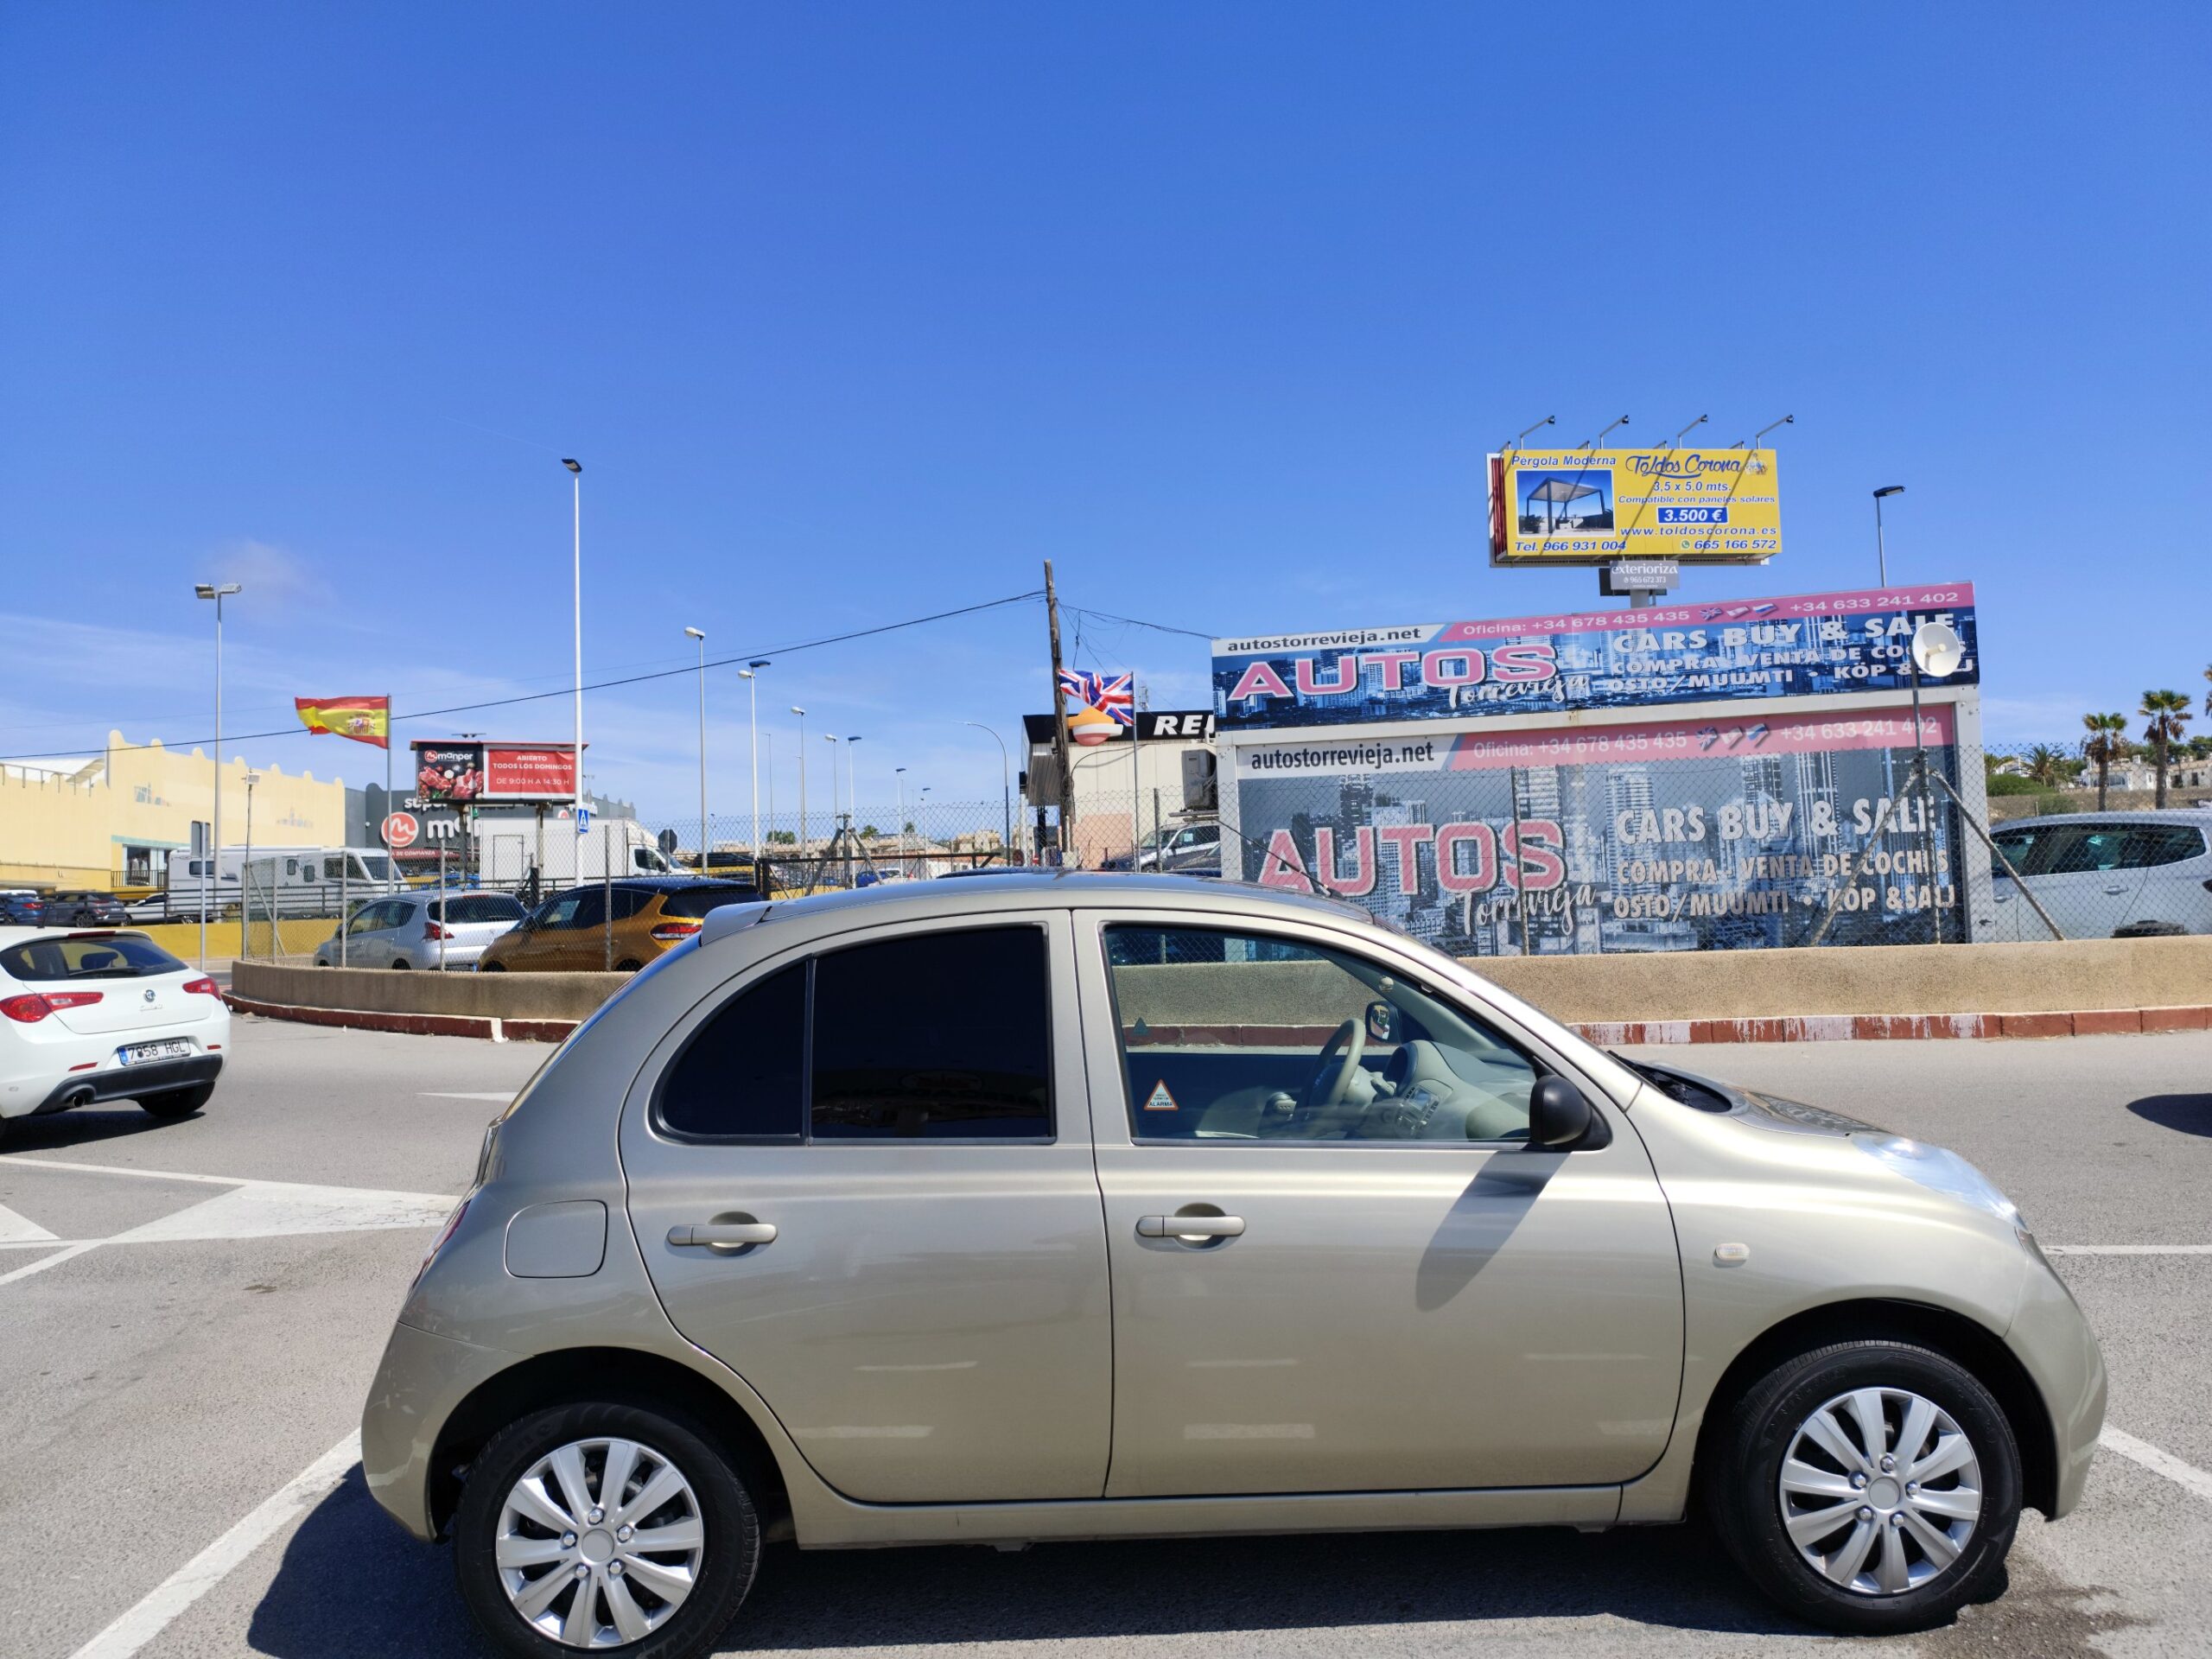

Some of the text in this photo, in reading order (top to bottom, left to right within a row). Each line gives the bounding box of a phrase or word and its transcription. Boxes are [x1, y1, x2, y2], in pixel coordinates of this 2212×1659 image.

[1511, 455, 1617, 467] Pérgola Moderna
[1625, 454, 1741, 476] Toldos Corona
[1653, 481, 1732, 493] 3,5 x 5,0 mts.
[1618, 495, 1675, 505] Compatible
[1698, 496, 1737, 505] paneles
[1663, 509, 1723, 522] 3.500 €
[1620, 525, 1777, 536] www.toldoscorona.es
[1515, 540, 1626, 551] Tel. 966 931 004
[1694, 540, 1777, 550] 665 166 572
[1611, 563, 1678, 575] exterioriza
[1789, 592, 1959, 613] +34 633 241 402
[1463, 610, 1690, 635] Oficina: +34 678 435 435
[1227, 627, 1421, 652] autostorrevieja.net
[1613, 630, 1708, 653] CARS
[1723, 623, 1802, 646] BUY
[1819, 620, 1849, 641] &
[1612, 657, 1719, 674] COMPRA
[1742, 650, 1821, 667] VENTA
[1830, 647, 1861, 661] DE
[1834, 662, 1887, 679] KÖP
[1226, 644, 1558, 702] AUTOS
[1445, 674, 1592, 710] Torrevieja
[1780, 724, 1816, 741] +34
[1821, 721, 1858, 739] 633
[1861, 718, 1897, 737] 241
[437, 750, 474, 762] manper
[1251, 741, 1434, 770] autostorrevieja.net
[1473, 731, 1688, 759] Oficina: +34 678 435 435
[1617, 806, 1707, 844] CARS
[1719, 802, 1794, 840] BUY
[1810, 800, 1839, 836] &
[1258, 818, 1566, 897] AUTOS
[1617, 858, 1719, 885] COMPRA
[1740, 854, 1815, 880] VENTA
[1822, 852, 1853, 877] DE
[164, 1041, 186, 1055] HGL
